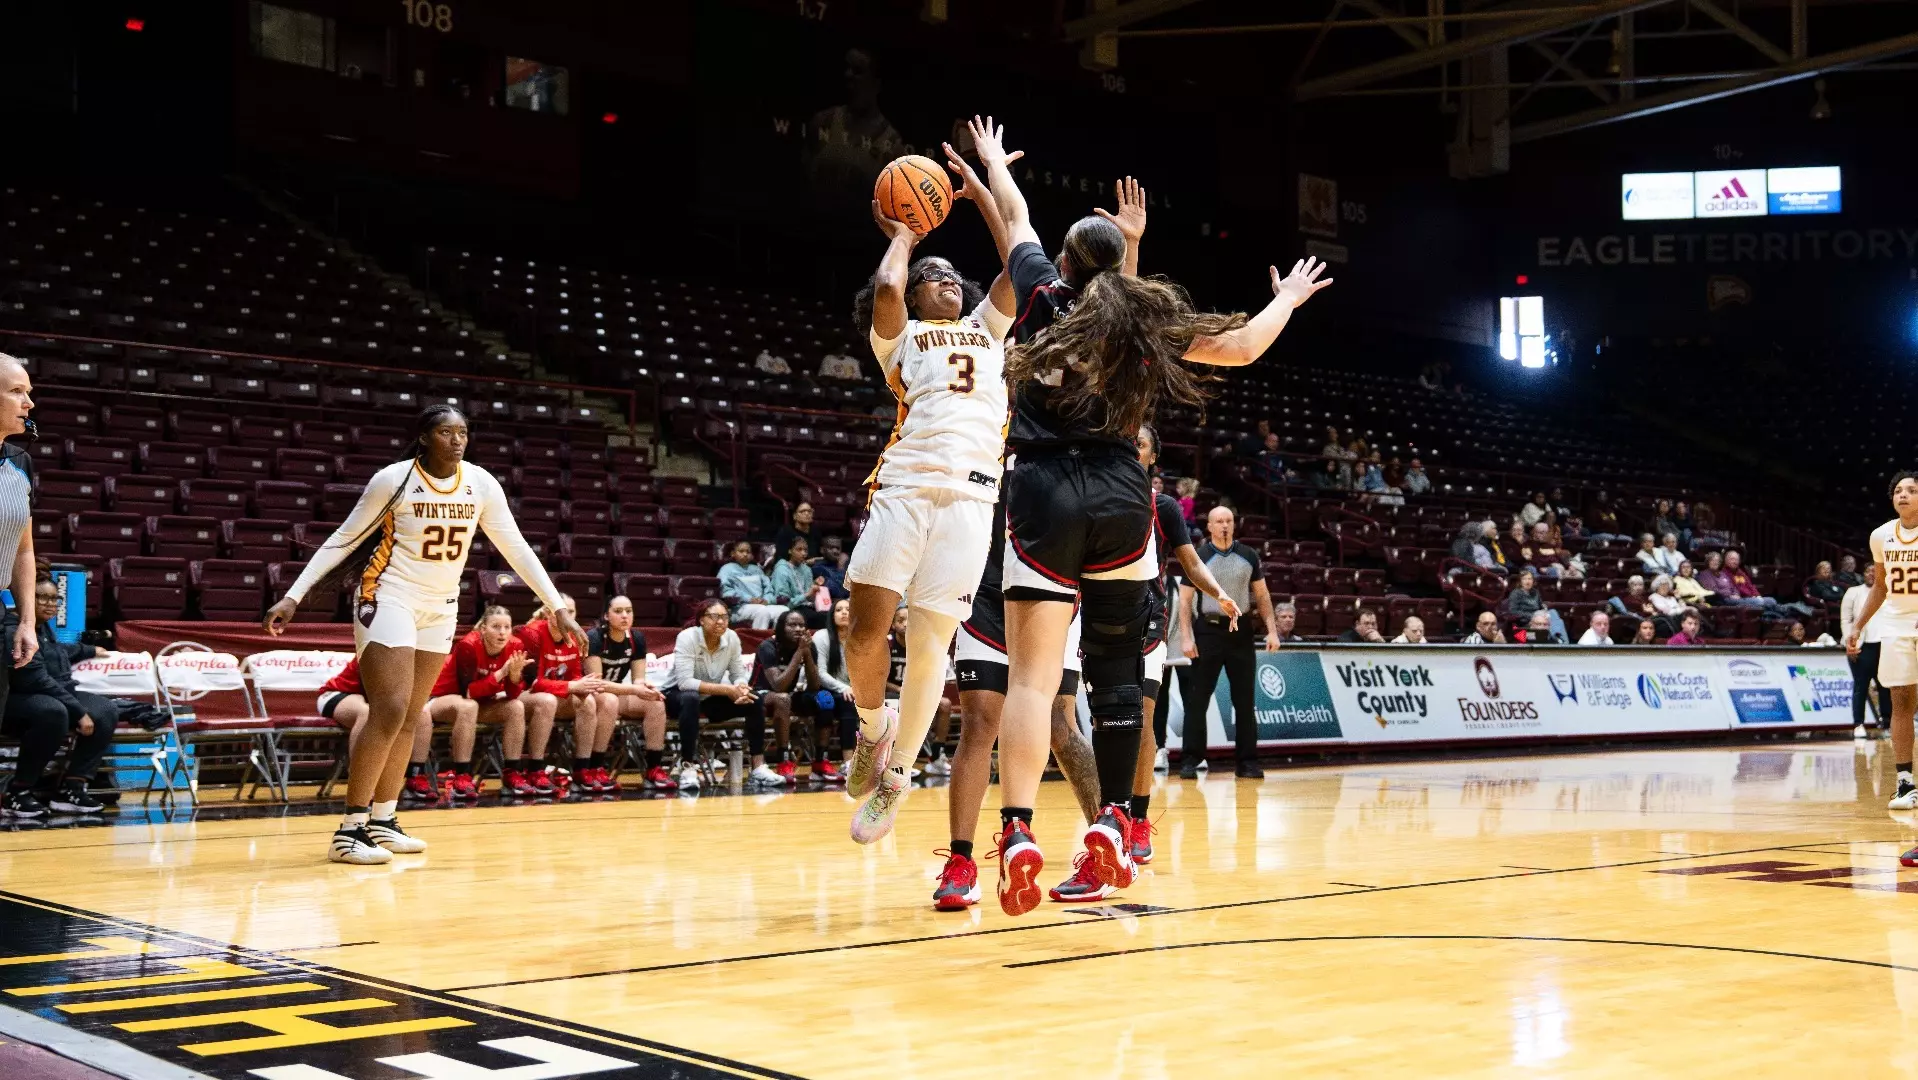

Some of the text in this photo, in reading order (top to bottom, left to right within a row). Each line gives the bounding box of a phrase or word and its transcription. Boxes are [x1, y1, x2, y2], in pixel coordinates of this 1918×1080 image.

[400, 0, 454, 33] 108
[1101, 72, 1127, 94] 106
[771, 115, 937, 158] WINTHROP
[1009, 165, 1173, 210] ASKETLL
[919, 177, 944, 223] Wilson
[1341, 200, 1367, 224] 105
[1705, 199, 1758, 212] adidas
[913, 329, 991, 353] WINTHROP
[948, 352, 975, 394] 3
[412, 502, 476, 520] WINTHROP
[421, 525, 468, 561] 25
[1890, 566, 1918, 594] 22
[252, 656, 323, 671] Coroplas
[605, 667, 621, 682] 11
[1336, 661, 1434, 688] Visit York
[1578, 674, 1626, 689] Williams
[1656, 672, 1708, 689] York County
[1662, 685, 1712, 700] Natural Gas
[1811, 678, 1854, 691] Educatio
[1357, 691, 1428, 717] County
[1457, 697, 1539, 721] FOUNDERS
[1817, 692, 1853, 708] Lotter
[1283, 704, 1333, 724] Health
